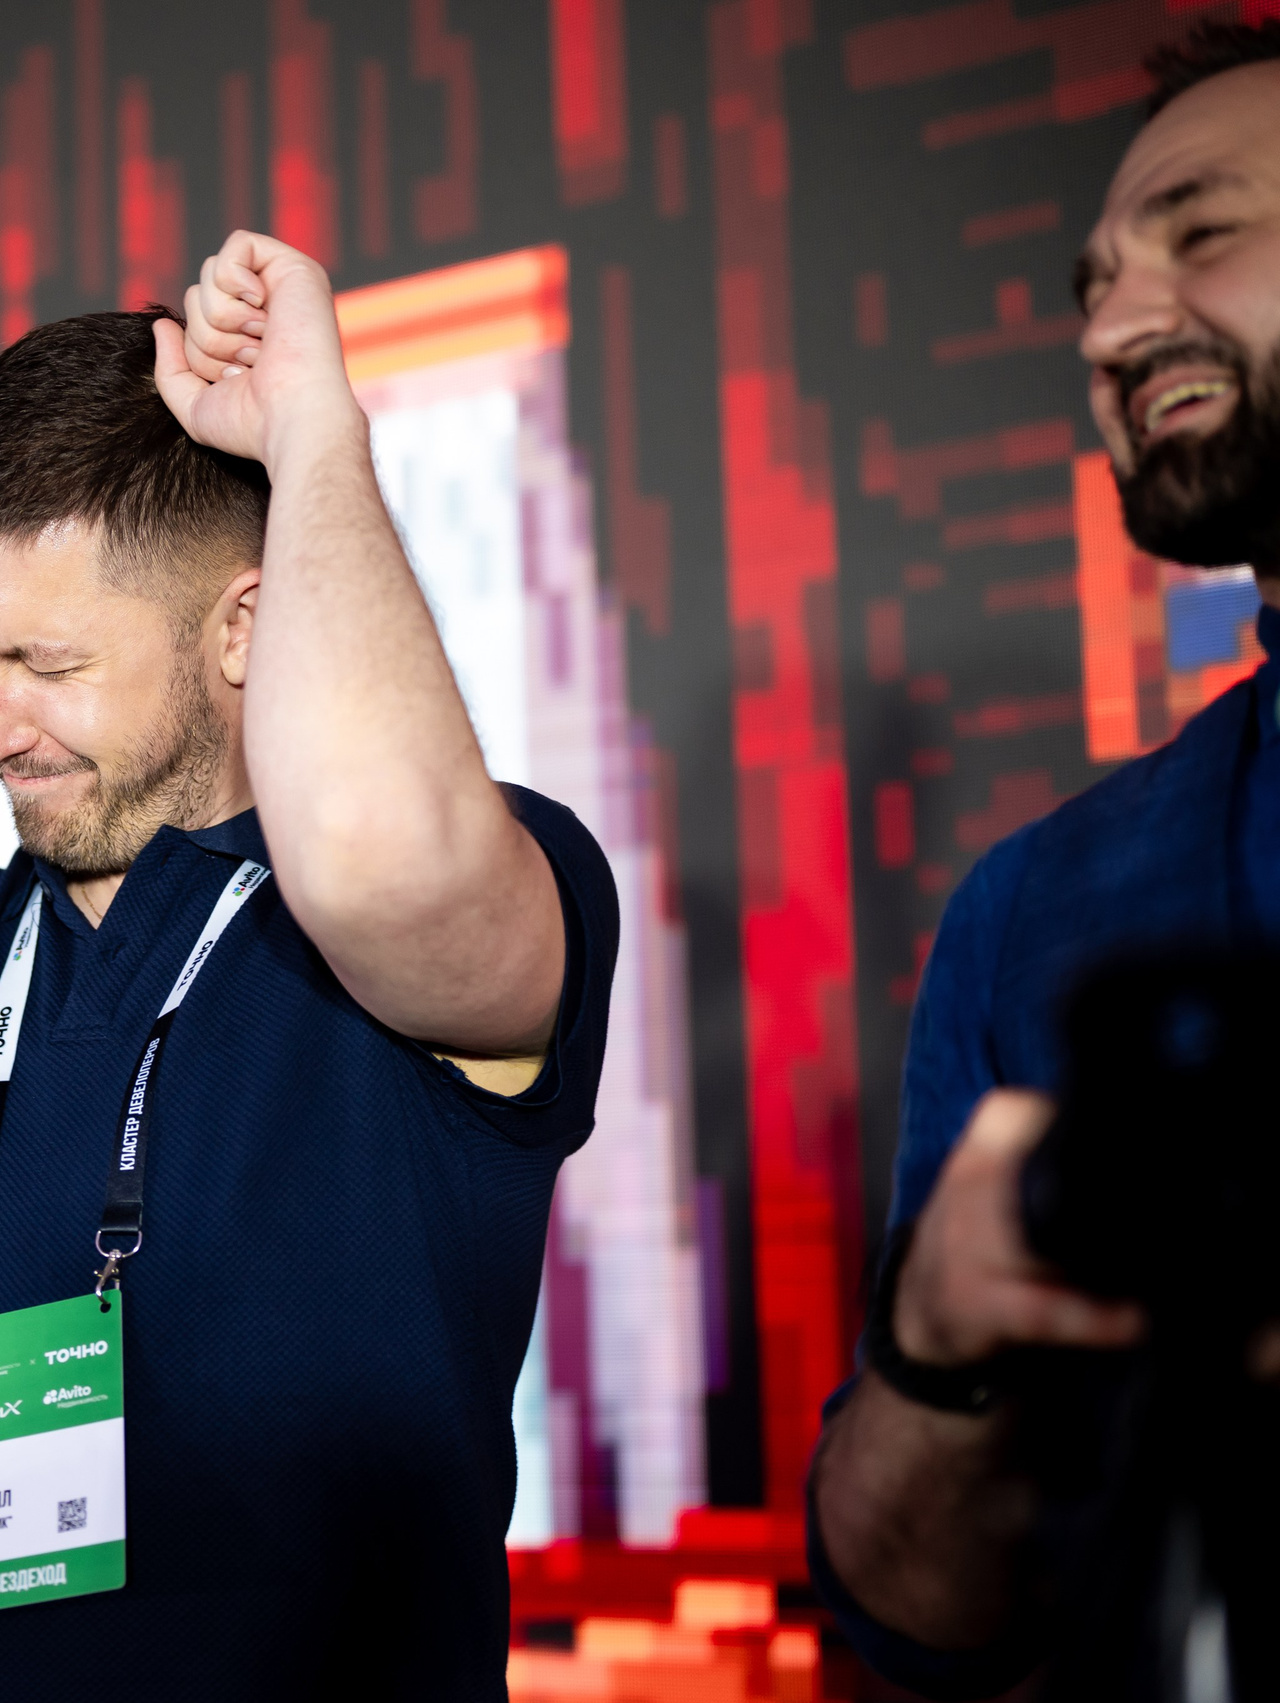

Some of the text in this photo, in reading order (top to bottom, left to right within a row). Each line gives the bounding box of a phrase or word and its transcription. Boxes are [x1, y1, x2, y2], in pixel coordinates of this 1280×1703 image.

[238, 866, 261, 888] Avito
[177, 940, 214, 992] ТОЧНО
[119, 1037, 161, 1171] КЛАСТЕР ДЕВЕЛОПЕРОВ
[44, 1340, 109, 1366] ТОЧНО
[57, 1384, 92, 1401] Avito
